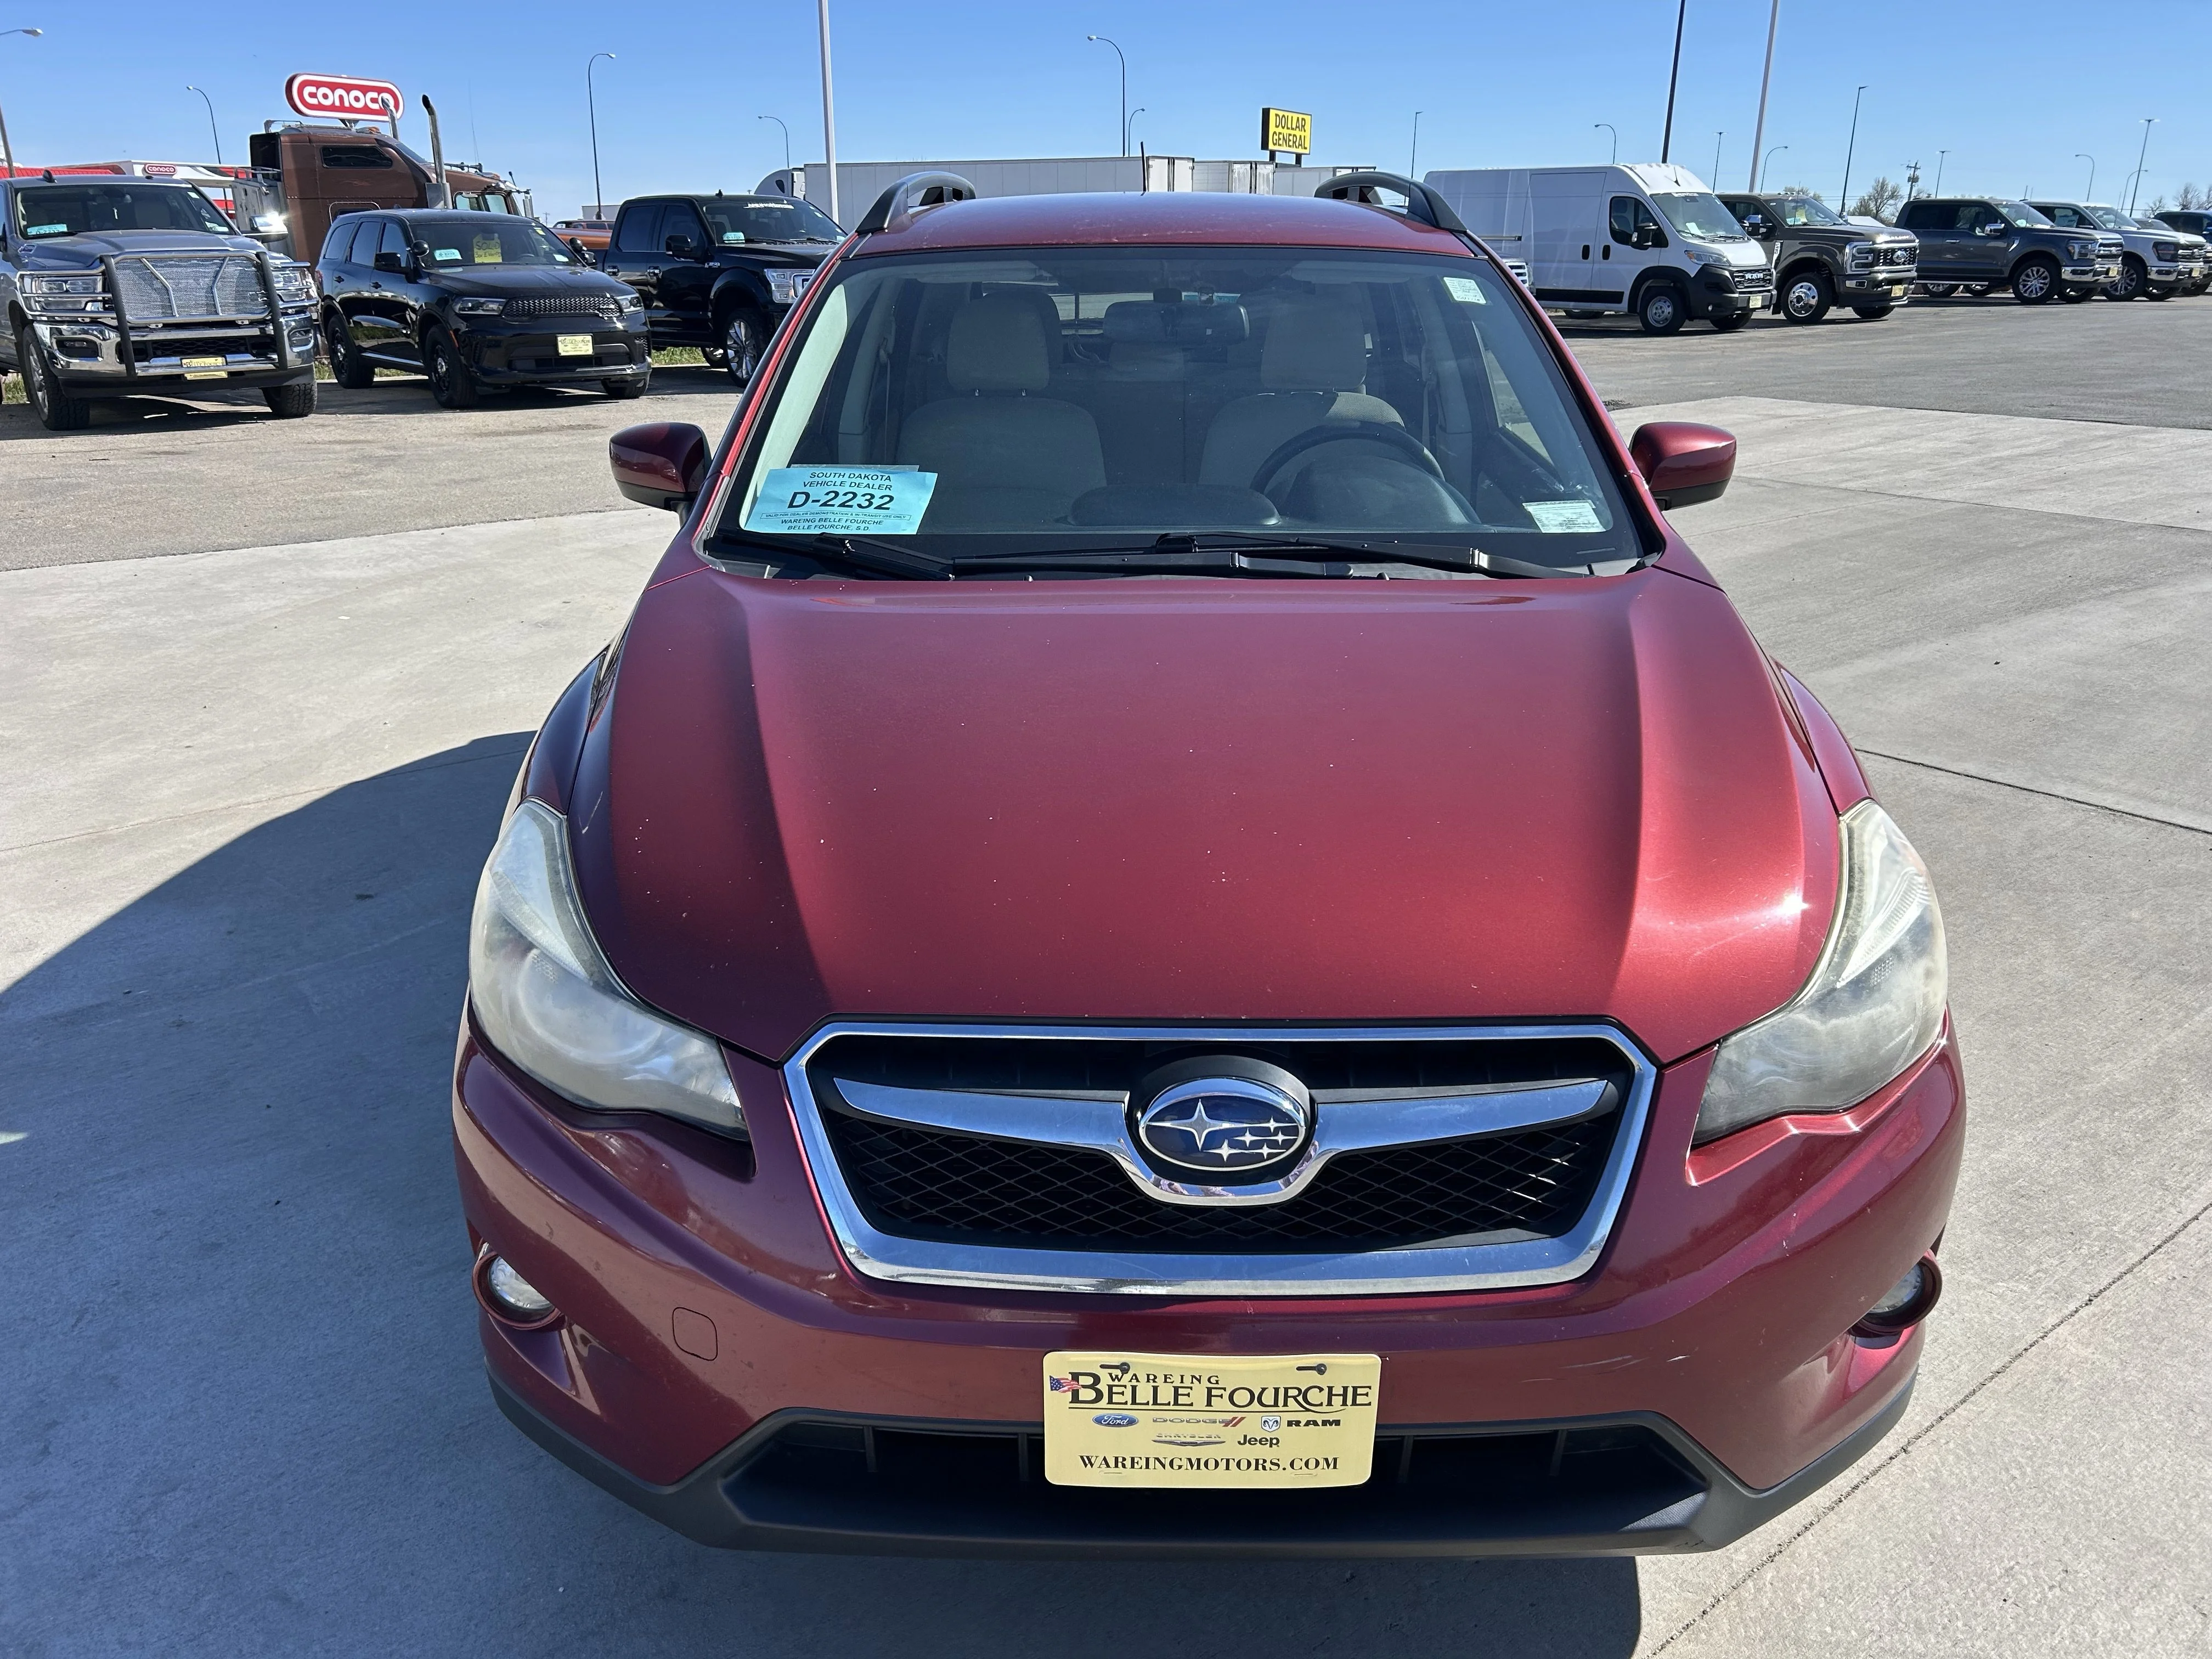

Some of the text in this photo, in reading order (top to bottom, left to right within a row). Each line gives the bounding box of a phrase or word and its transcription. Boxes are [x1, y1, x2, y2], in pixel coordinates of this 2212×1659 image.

[1275, 113, 1306, 132] DOLLAR
[1272, 131, 1307, 150] GENERAL
[848, 473, 891, 482] DAKOTA
[849, 482, 893, 491] DEALER
[787, 490, 894, 511] D-2232
[1107, 1372, 1220, 1385] WAREING
[1069, 1371, 1372, 1410] BELLE FOURCHE
[1101, 1415, 1129, 1426] Ford
[1237, 1434, 1280, 1448] Jeep
[1079, 1455, 1340, 1471] WAREINGMOTORS.COM
